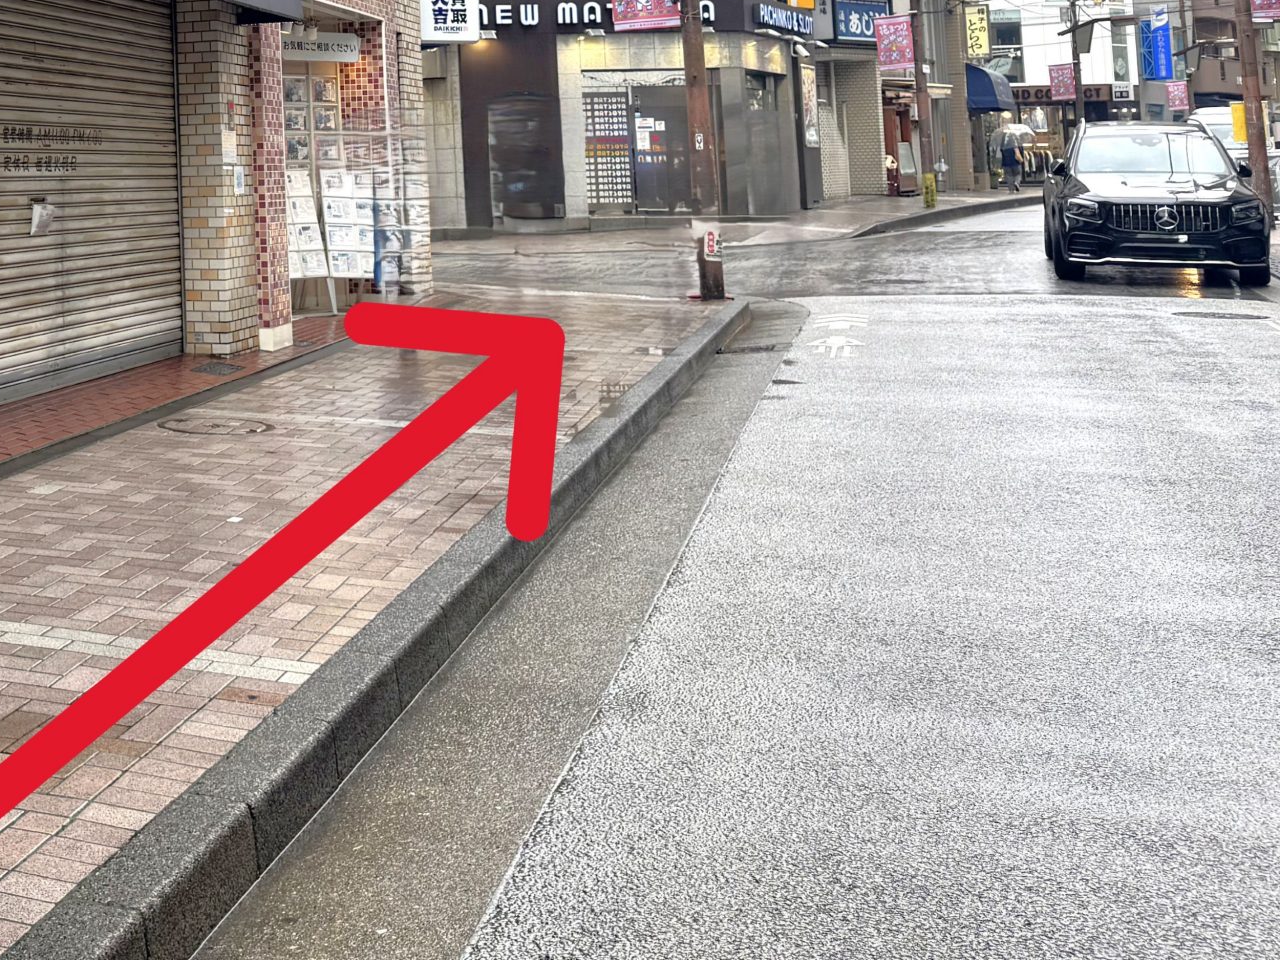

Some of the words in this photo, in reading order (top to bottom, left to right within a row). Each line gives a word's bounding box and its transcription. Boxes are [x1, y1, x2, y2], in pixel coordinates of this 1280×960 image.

[760, 3, 793, 30] PACHINKO
[792, 17, 798, 32] &
[798, 18, 813, 34] SLOT
[282, 40, 358, 53] お気軽にご相談ください
[968, 19, 983, 54] とらや
